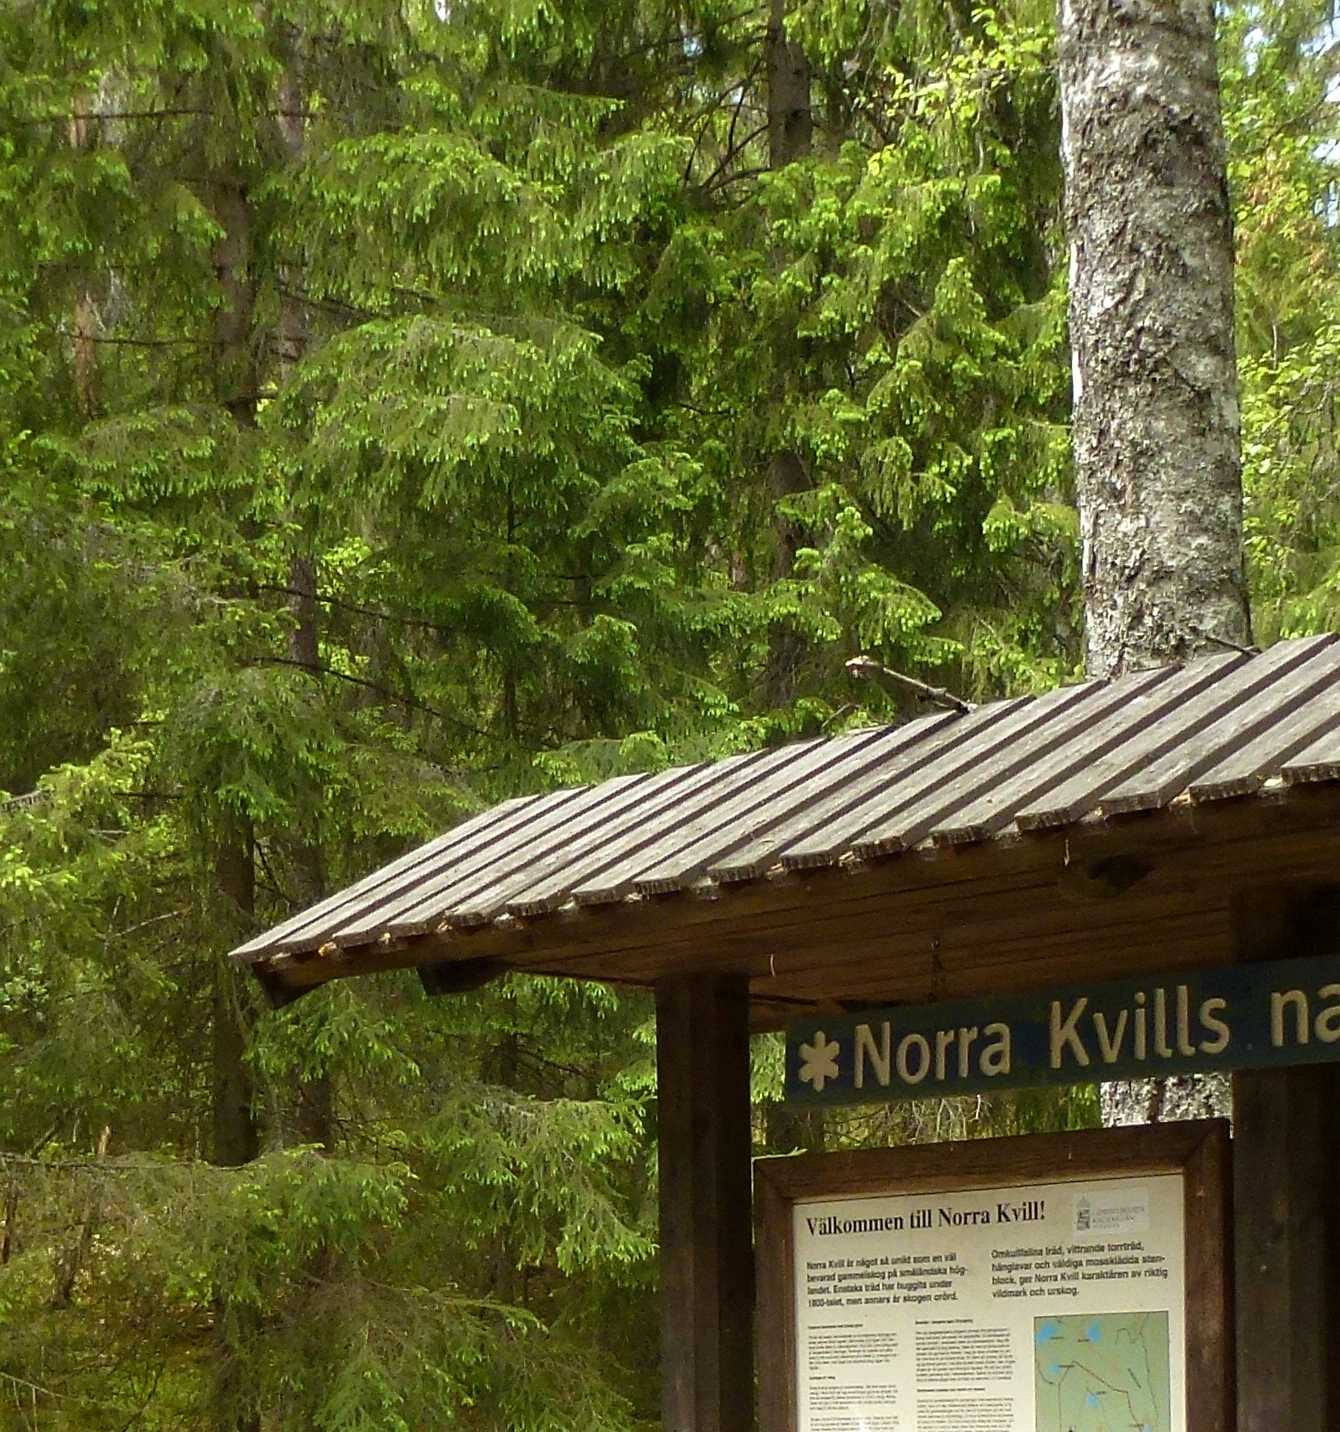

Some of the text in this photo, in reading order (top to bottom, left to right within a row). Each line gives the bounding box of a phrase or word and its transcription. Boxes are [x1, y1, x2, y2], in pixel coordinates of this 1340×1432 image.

[853, 1020, 1011, 1090] Norra
[1049, 984, 1231, 1070] Kvills
[806, 1200, 1045, 1237] Välkommen till Norra Kvill!
[1066, 1243, 1105, 1254] vittrande
[1107, 1241, 1144, 1252] torrträd,
[807, 1252, 957, 1270] Norra Kvill är något så unikt som en väl
[991, 1254, 1166, 1274] hänglavar och väldiga mossklädda sten-
[807, 1265, 968, 1283] bevarad gammelskog på småländska hög-
[992, 1267, 1168, 1286] block, ger Norra Kvill karaktären av riktig
[833, 1283, 863, 1294] Enstaka
[865, 1281, 880, 1292] träd
[882, 1281, 894, 1291] har
[897, 1280, 927, 1292] huggits
[929, 1279, 952, 1288] under
[992, 1285, 1079, 1298] vildmark och urskog.
[846, 1297, 862, 1305] men
[892, 1295, 900, 1303] är
[903, 1293, 932, 1304] skogen
